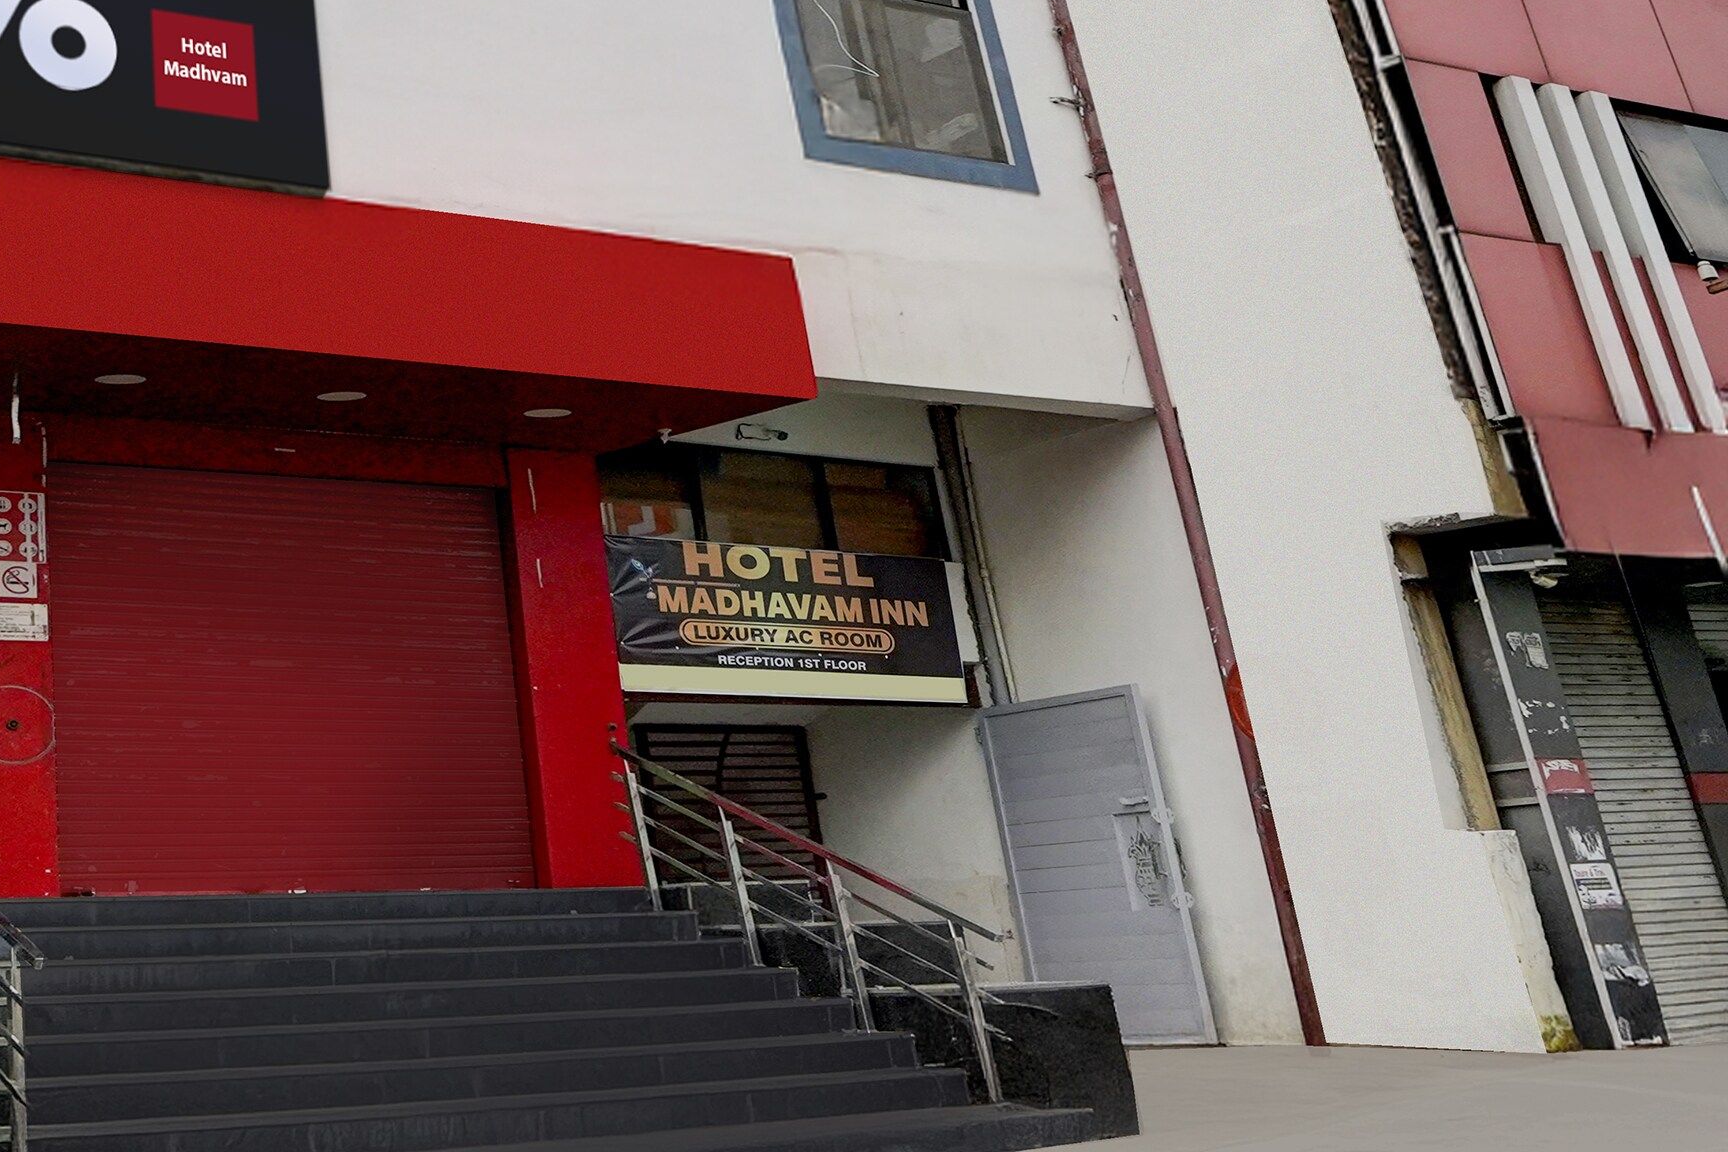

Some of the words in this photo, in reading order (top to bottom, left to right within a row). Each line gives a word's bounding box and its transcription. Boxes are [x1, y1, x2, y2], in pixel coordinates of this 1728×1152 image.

[181, 37, 228, 60] Hotel
[163, 60, 248, 88] Madhvam
[682, 541, 875, 587] HOTEL
[657, 585, 864, 623] MADHAVAM
[869, 598, 929, 627] INN
[693, 625, 777, 643] LUXURY
[785, 629, 813, 645] AC
[820, 631, 883, 648] ROOM
[718, 654, 794, 668] RECEPTION
[798, 658, 821, 669] 1ST
[824, 659, 867, 671] FLOOR
